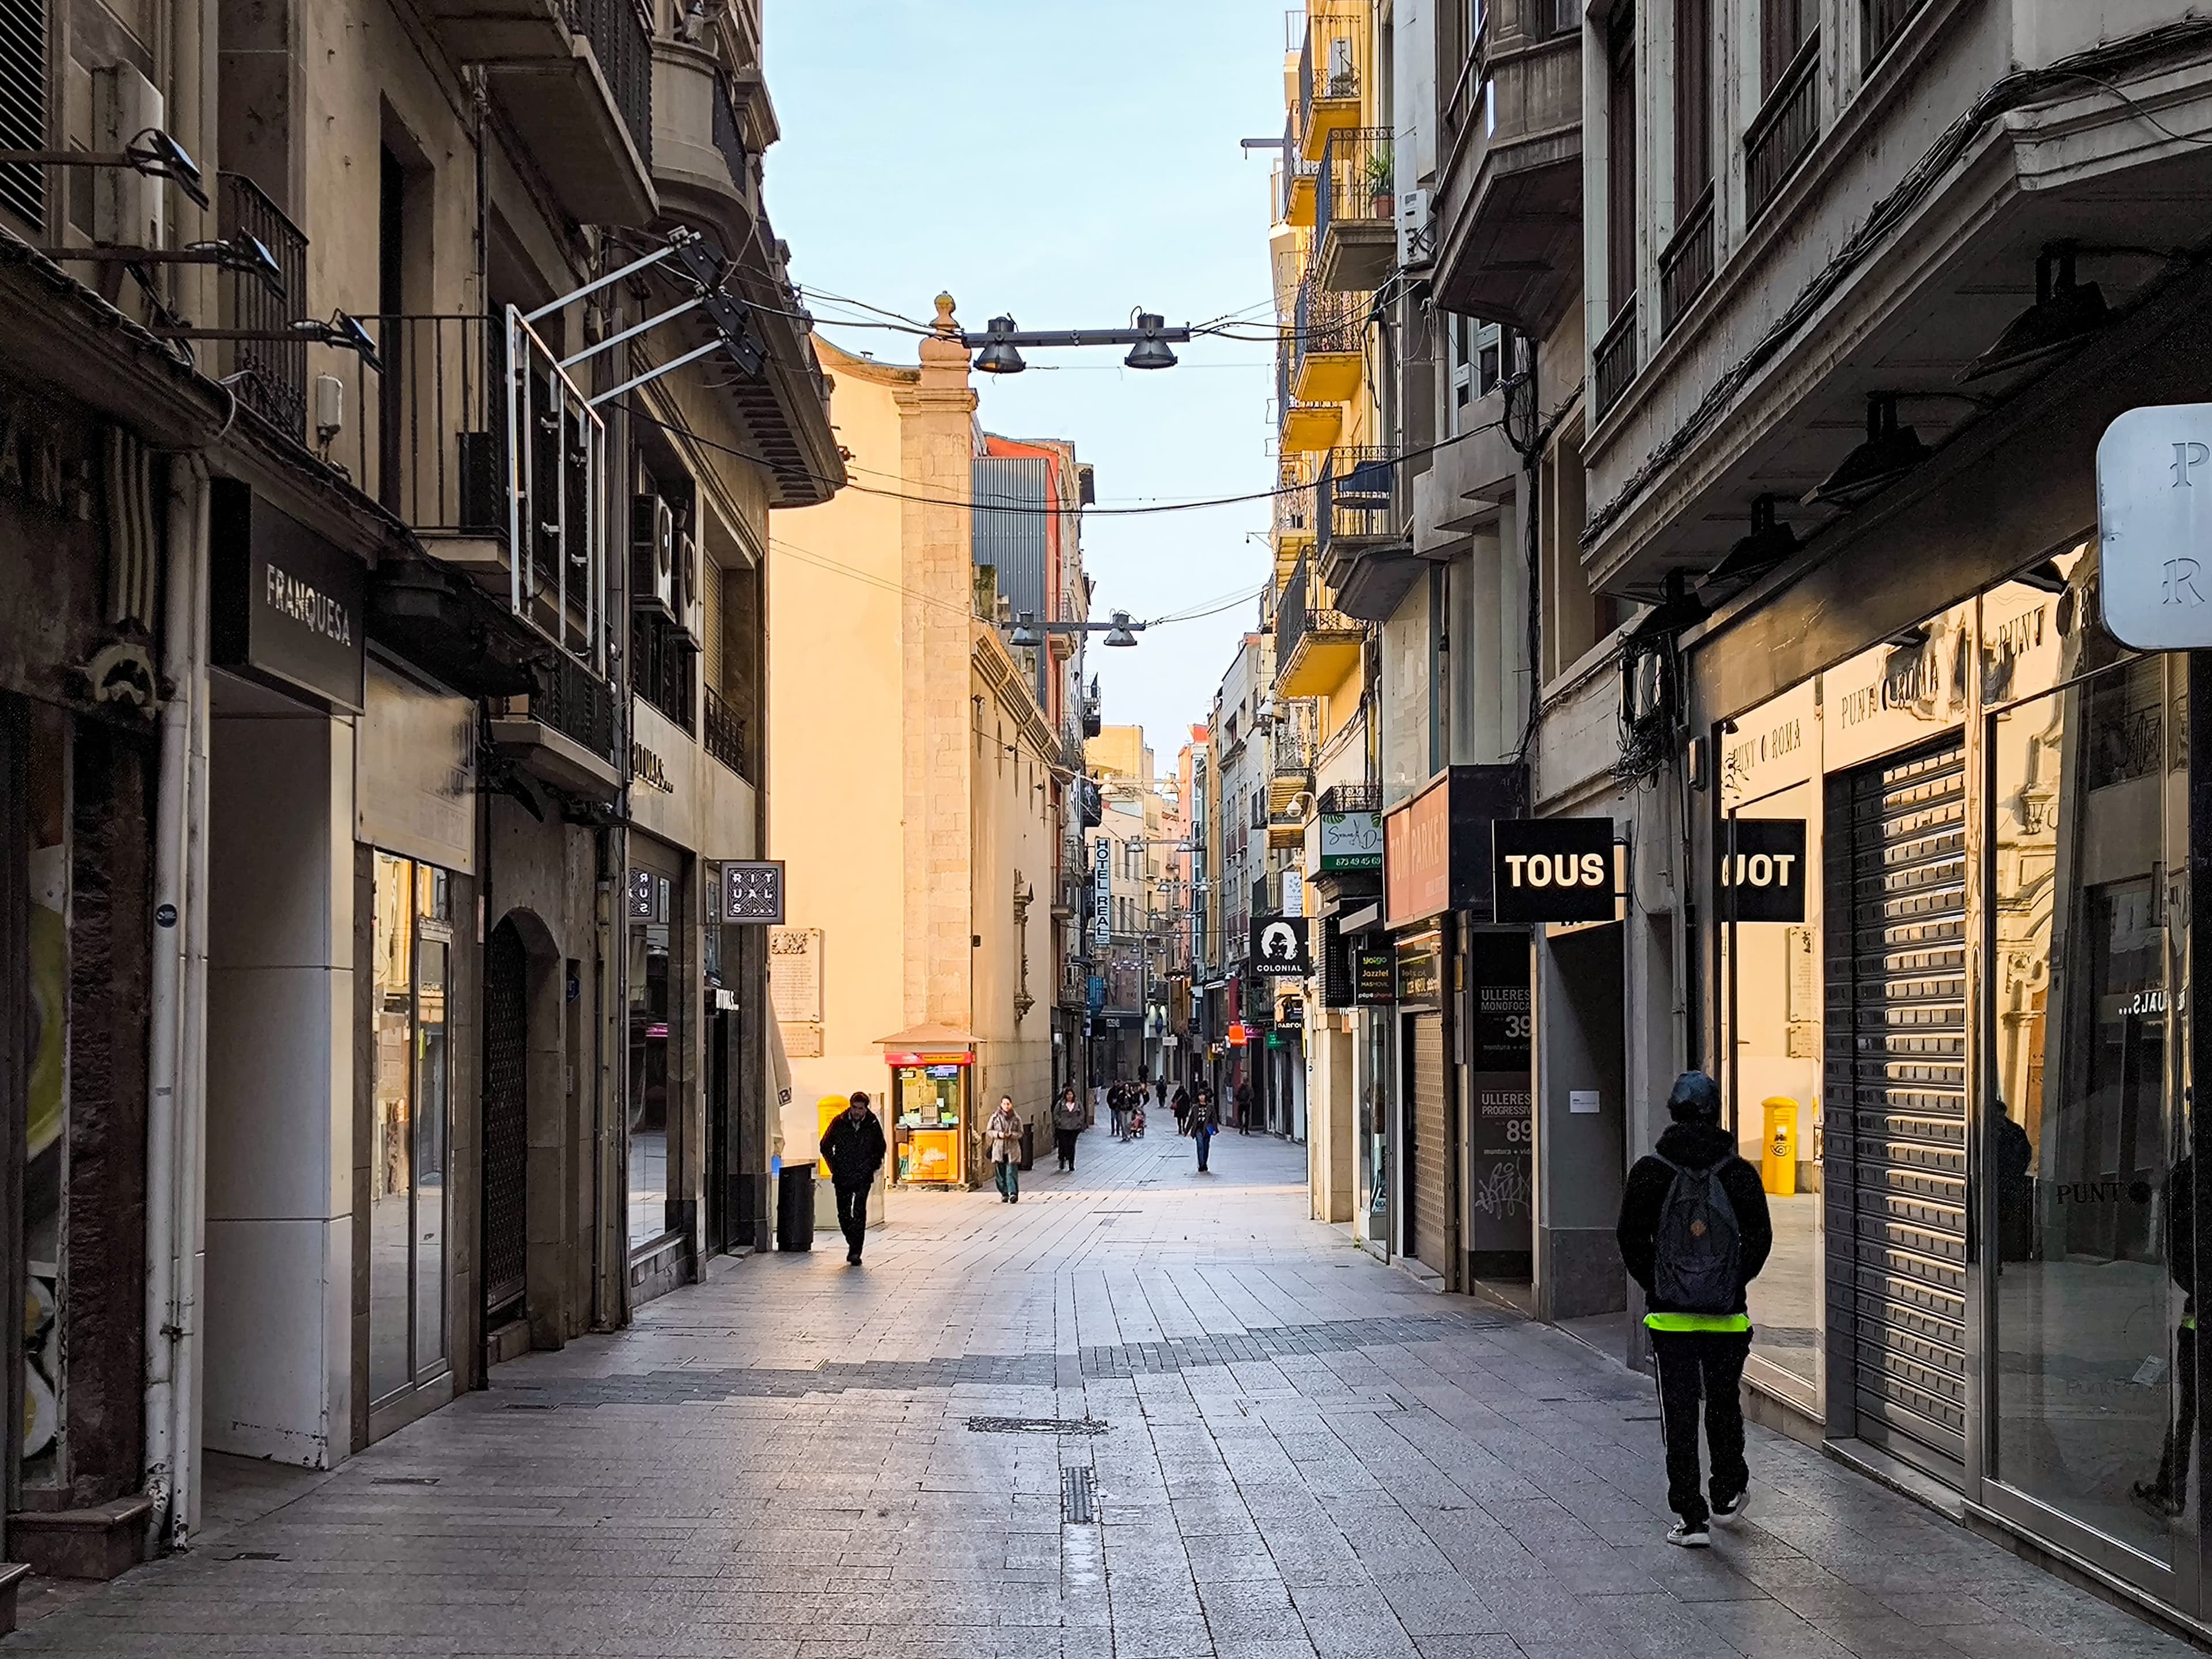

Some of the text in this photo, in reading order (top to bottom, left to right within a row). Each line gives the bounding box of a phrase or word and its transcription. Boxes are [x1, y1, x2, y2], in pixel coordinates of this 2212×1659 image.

[267, 563, 351, 646] FRANQUESA
[1998, 603, 2047, 664] PUNT
[1772, 719, 1801, 759] ROMA
[1097, 840, 1108, 890] HOTEL
[1389, 812, 1446, 882] TOM PARKER
[1505, 853, 1604, 887] TOUS
[1097, 896, 1108, 936] REAL
[1481, 989, 1531, 1001] ULLERES
[1481, 1002, 1531, 1010] MONOFOCA
[1482, 1093, 1531, 1105] ULLERES
[1482, 1106, 1531, 1115] PROGRESSIV
